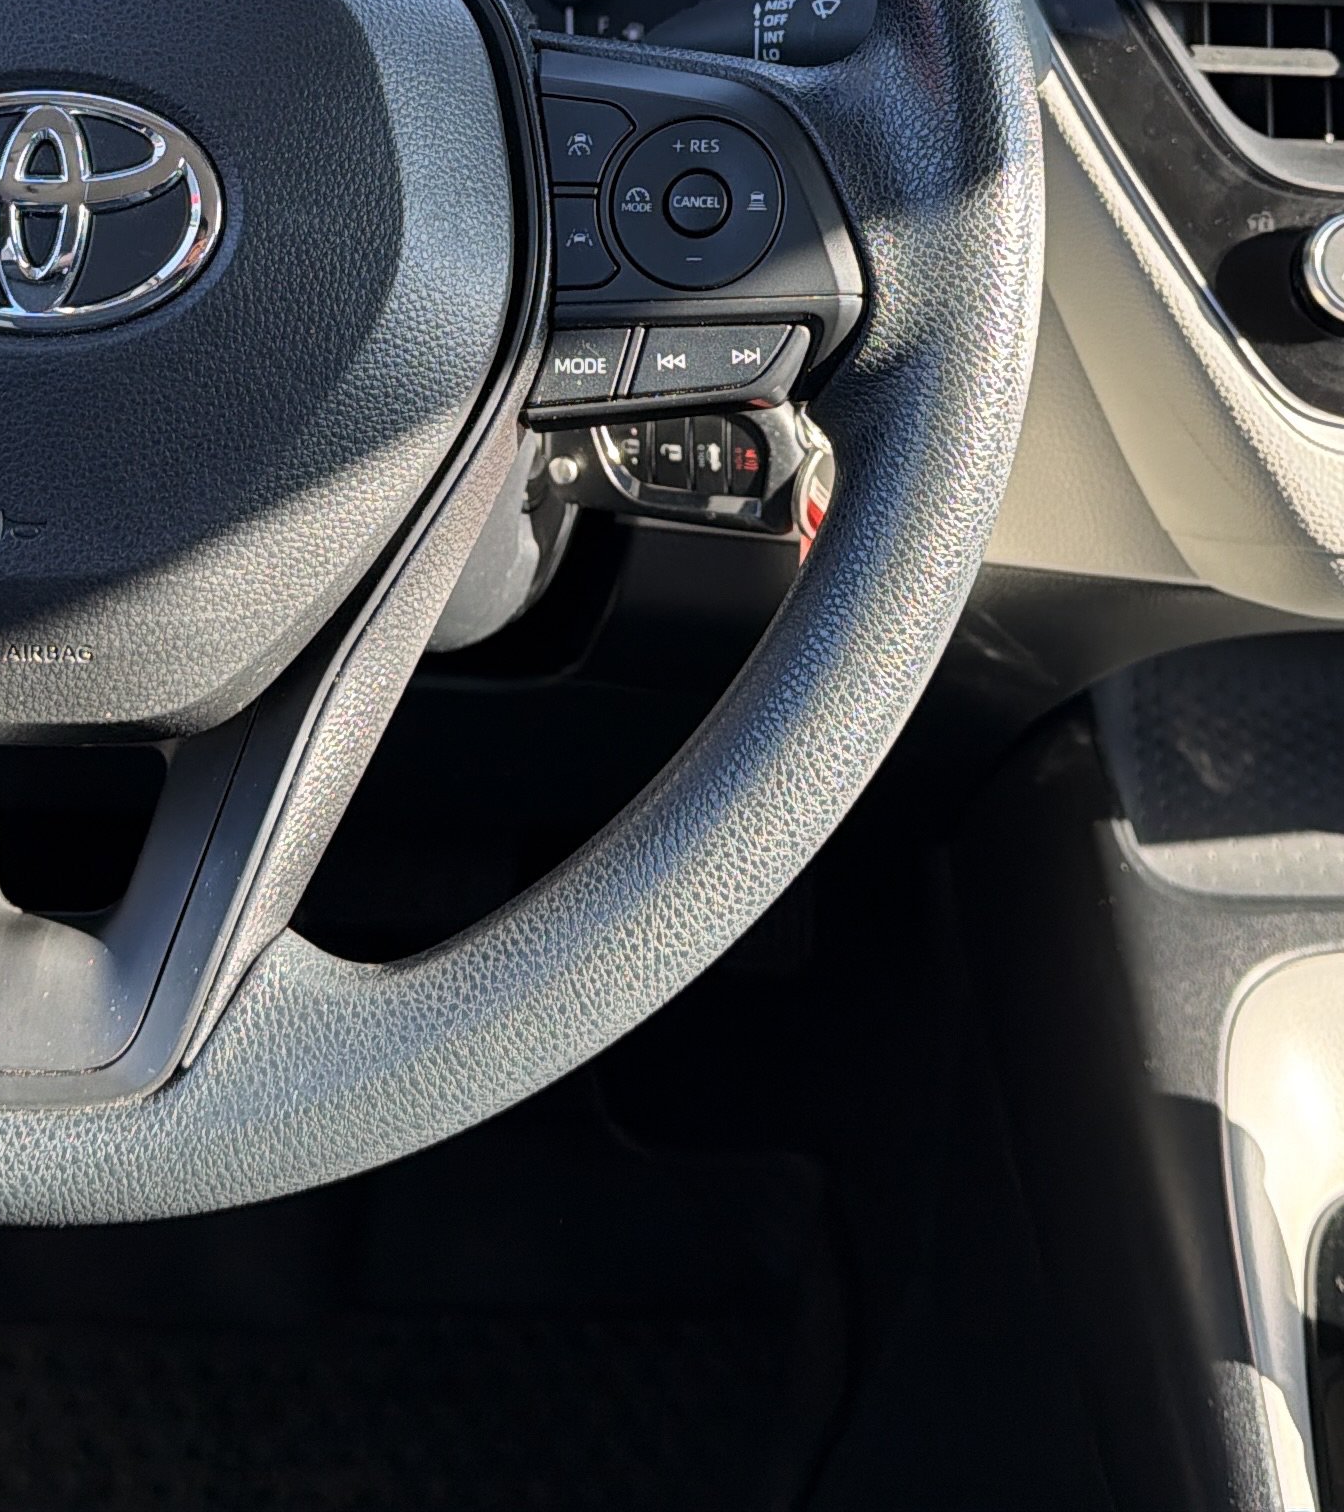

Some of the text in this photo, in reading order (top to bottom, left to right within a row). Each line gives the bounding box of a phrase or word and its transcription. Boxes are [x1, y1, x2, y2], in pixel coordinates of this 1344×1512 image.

[762, 13, 789, 27] OFF
[763, 30, 785, 44] INT
[762, 48, 781, 61] LO
[689, 139, 720, 154] RES
[621, 201, 653, 213] MODE
[672, 194, 721, 209] CANCEL
[554, 357, 607, 375] MODE
[5, 643, 95, 665] AIRBAG
